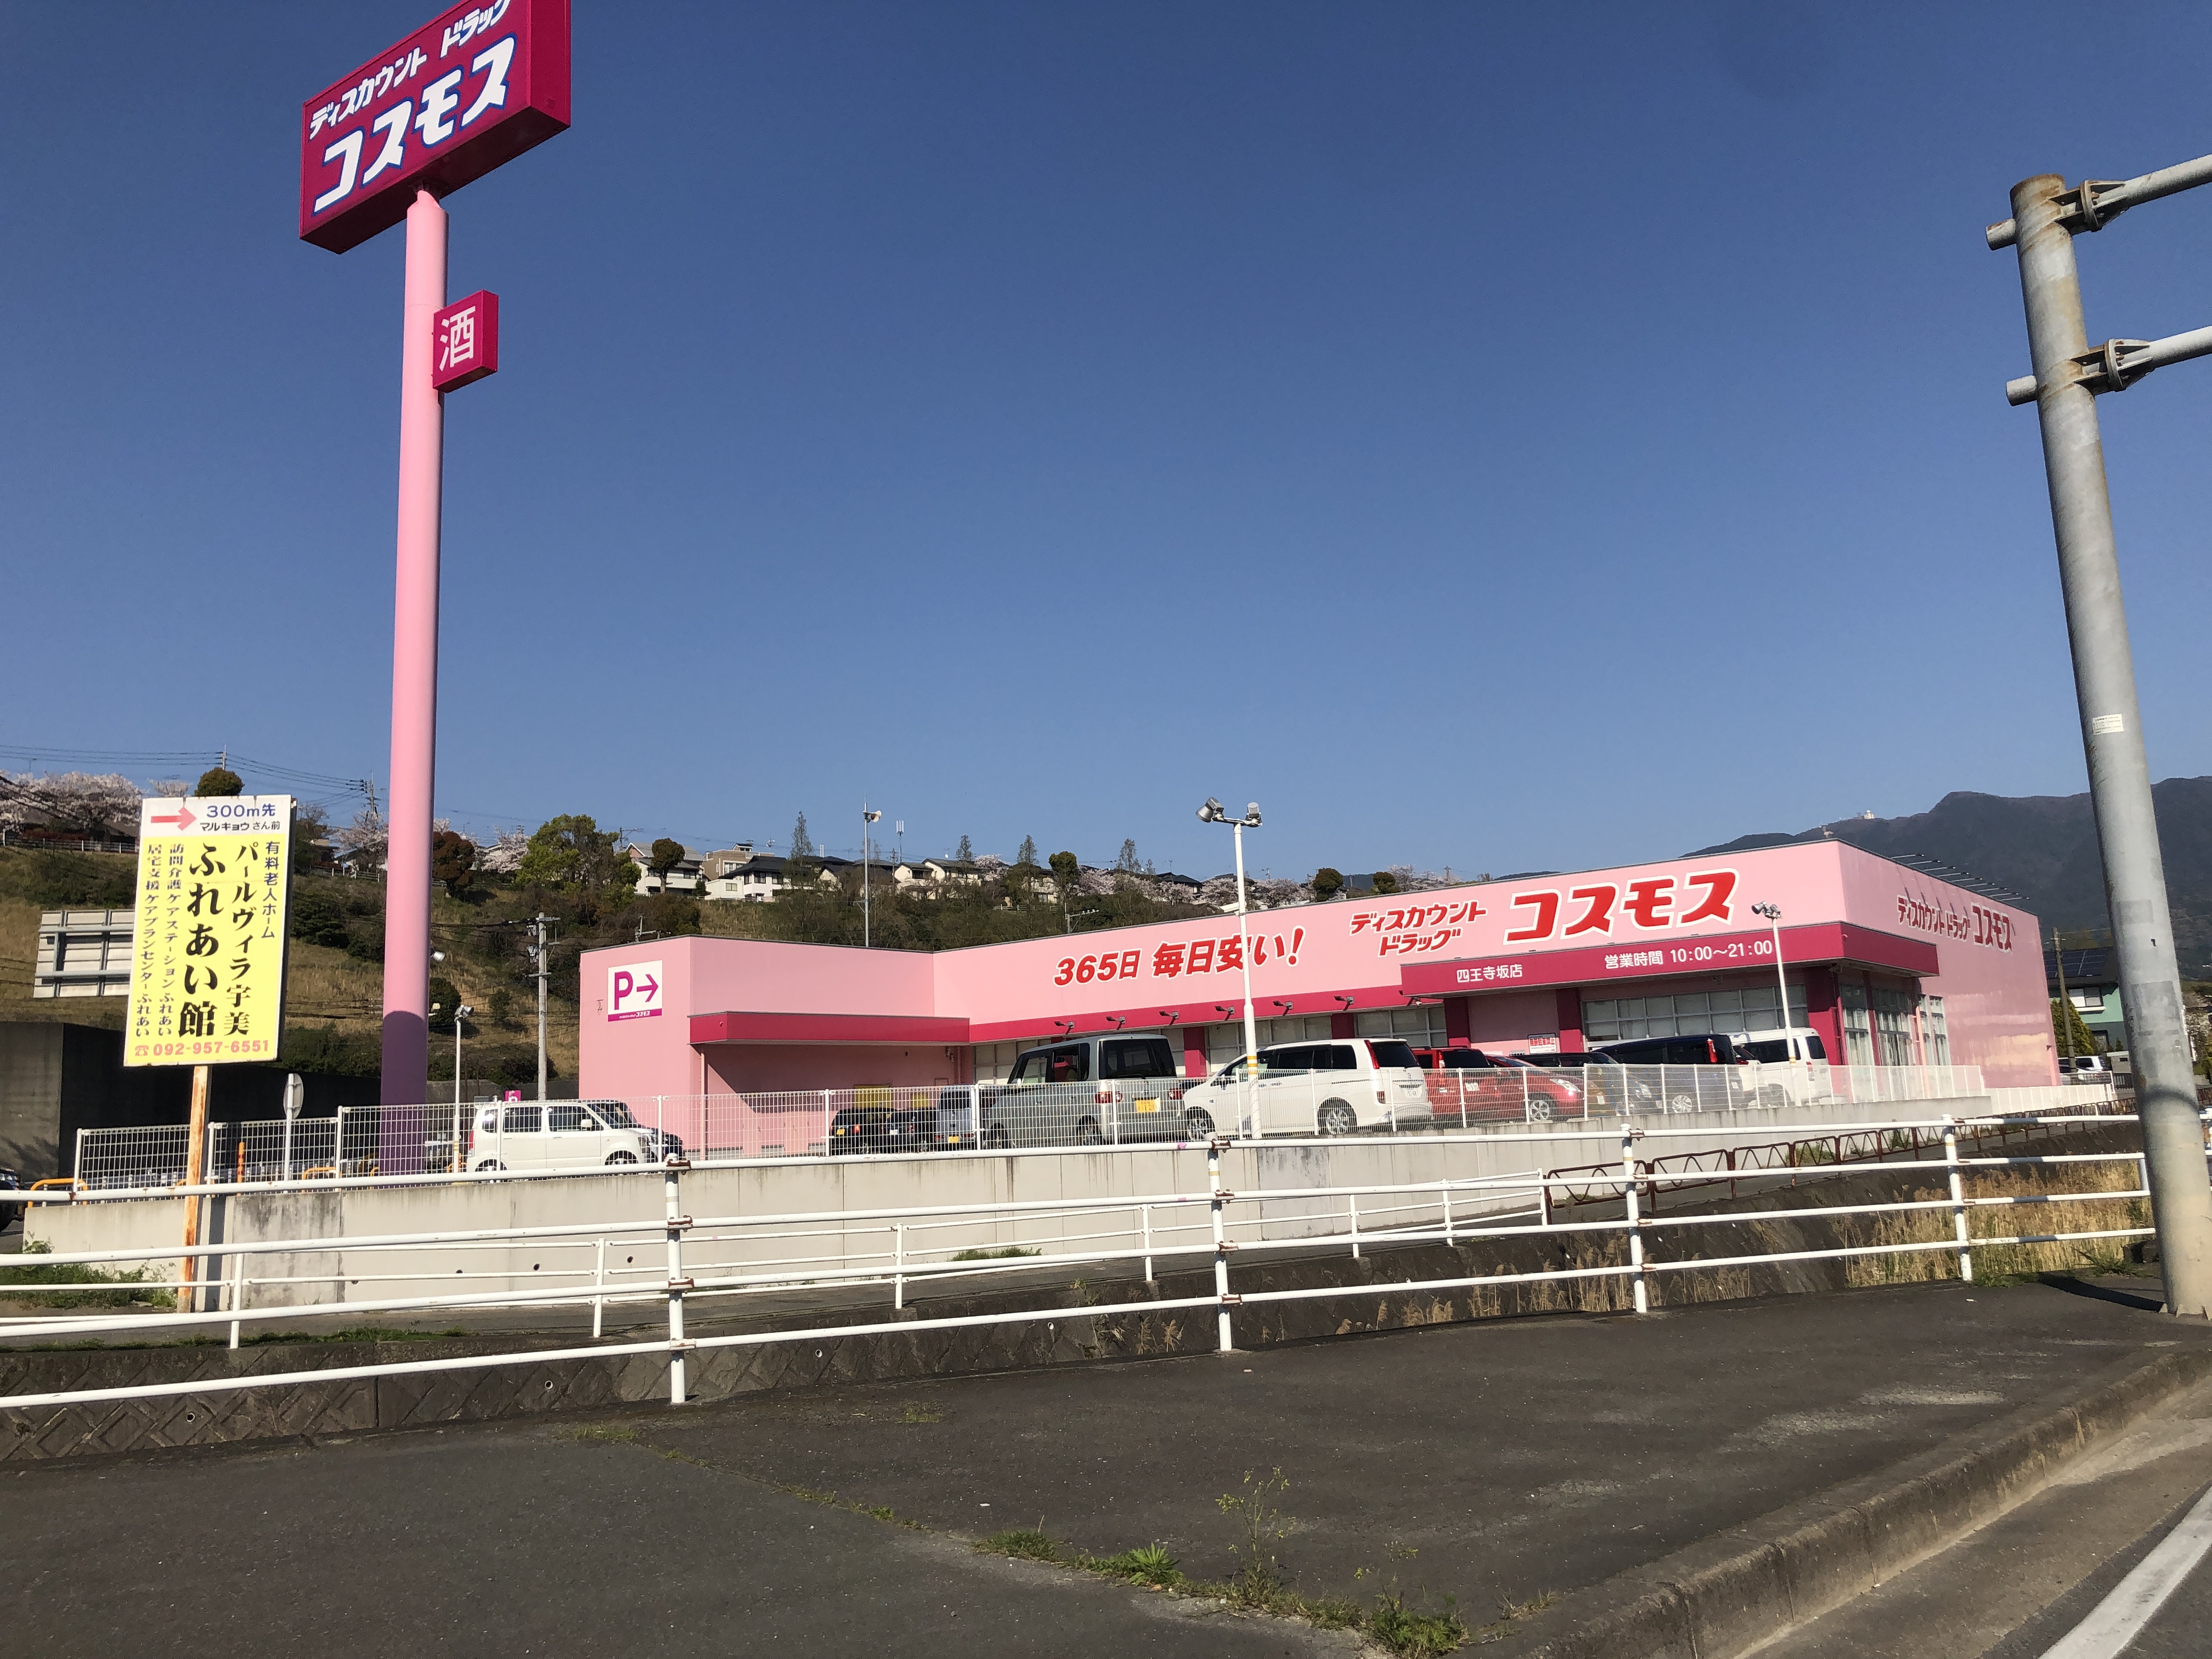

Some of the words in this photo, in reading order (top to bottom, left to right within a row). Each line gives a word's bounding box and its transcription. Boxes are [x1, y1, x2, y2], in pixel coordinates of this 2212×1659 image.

[309, 47, 427, 140] ディスカウント
[312, 34, 516, 215] コスモス
[439, 306, 476, 371] 酒
[206, 803, 276, 818] 300m先
[261, 841, 280, 939] 有料老人ホーム
[1349, 900, 1487, 936] ディスカウント
[1503, 868, 1740, 945] コスモス
[178, 843, 225, 1038] ふれあい館
[224, 842, 259, 1036] パールヴィラ宇美
[1378, 927, 1462, 957] ドラッグ
[1897, 894, 1945, 936] ディスカウント
[1945, 910, 1971, 942] ドラッグ
[1971, 902, 2012, 953] コスモス
[614, 970, 634, 1010] P
[1053, 949, 1142, 987] 365日
[1456, 963, 1523, 984] 四王寺坂店
[1605, 950, 1663, 970] 営業時間
[153, 1040, 269, 1056] 092-957-6551
